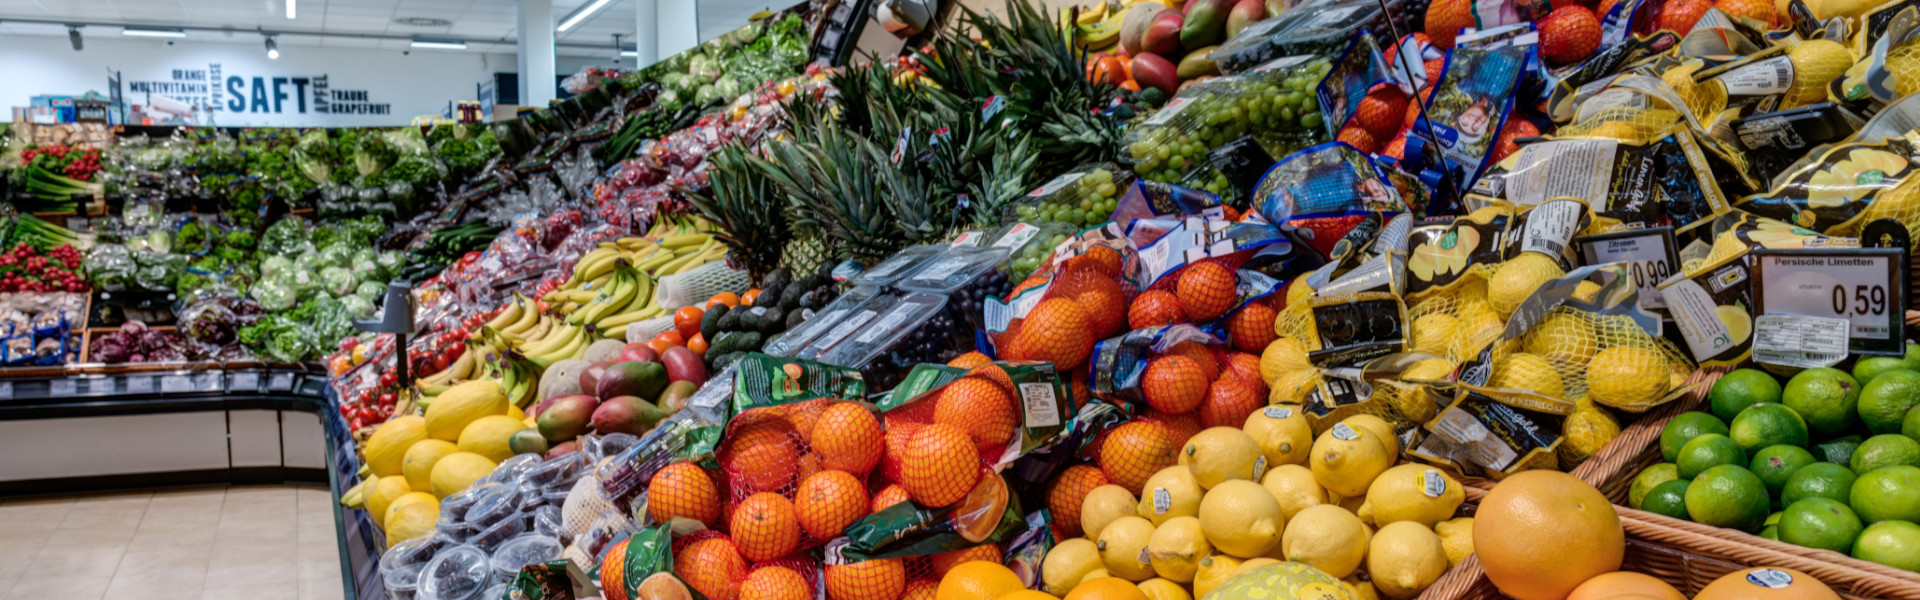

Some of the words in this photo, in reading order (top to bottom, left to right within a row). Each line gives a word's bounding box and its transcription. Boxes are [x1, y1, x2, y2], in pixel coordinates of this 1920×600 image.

[172, 69, 207, 81] ORANGE
[129, 81, 208, 93] MULTIVITAMIN
[210, 63, 223, 111] APRIKOSE
[226, 76, 309, 114] SAFT
[313, 73, 330, 114] APFEL
[331, 89, 368, 101] TRAUBE
[331, 103, 391, 115] GRAPEFRUIT
[1677, 131, 1689, 147] DIE
[1700, 173, 1723, 210] KERNLOSE
[1608, 239, 1637, 248] Zitronen
[1774, 257, 1825, 267] Persische
[1827, 257, 1874, 267] Limetten
[1633, 259, 1669, 292] 0,99
[1832, 284, 1886, 318] 0,59
[1518, 397, 1566, 413] KERNLOSE
